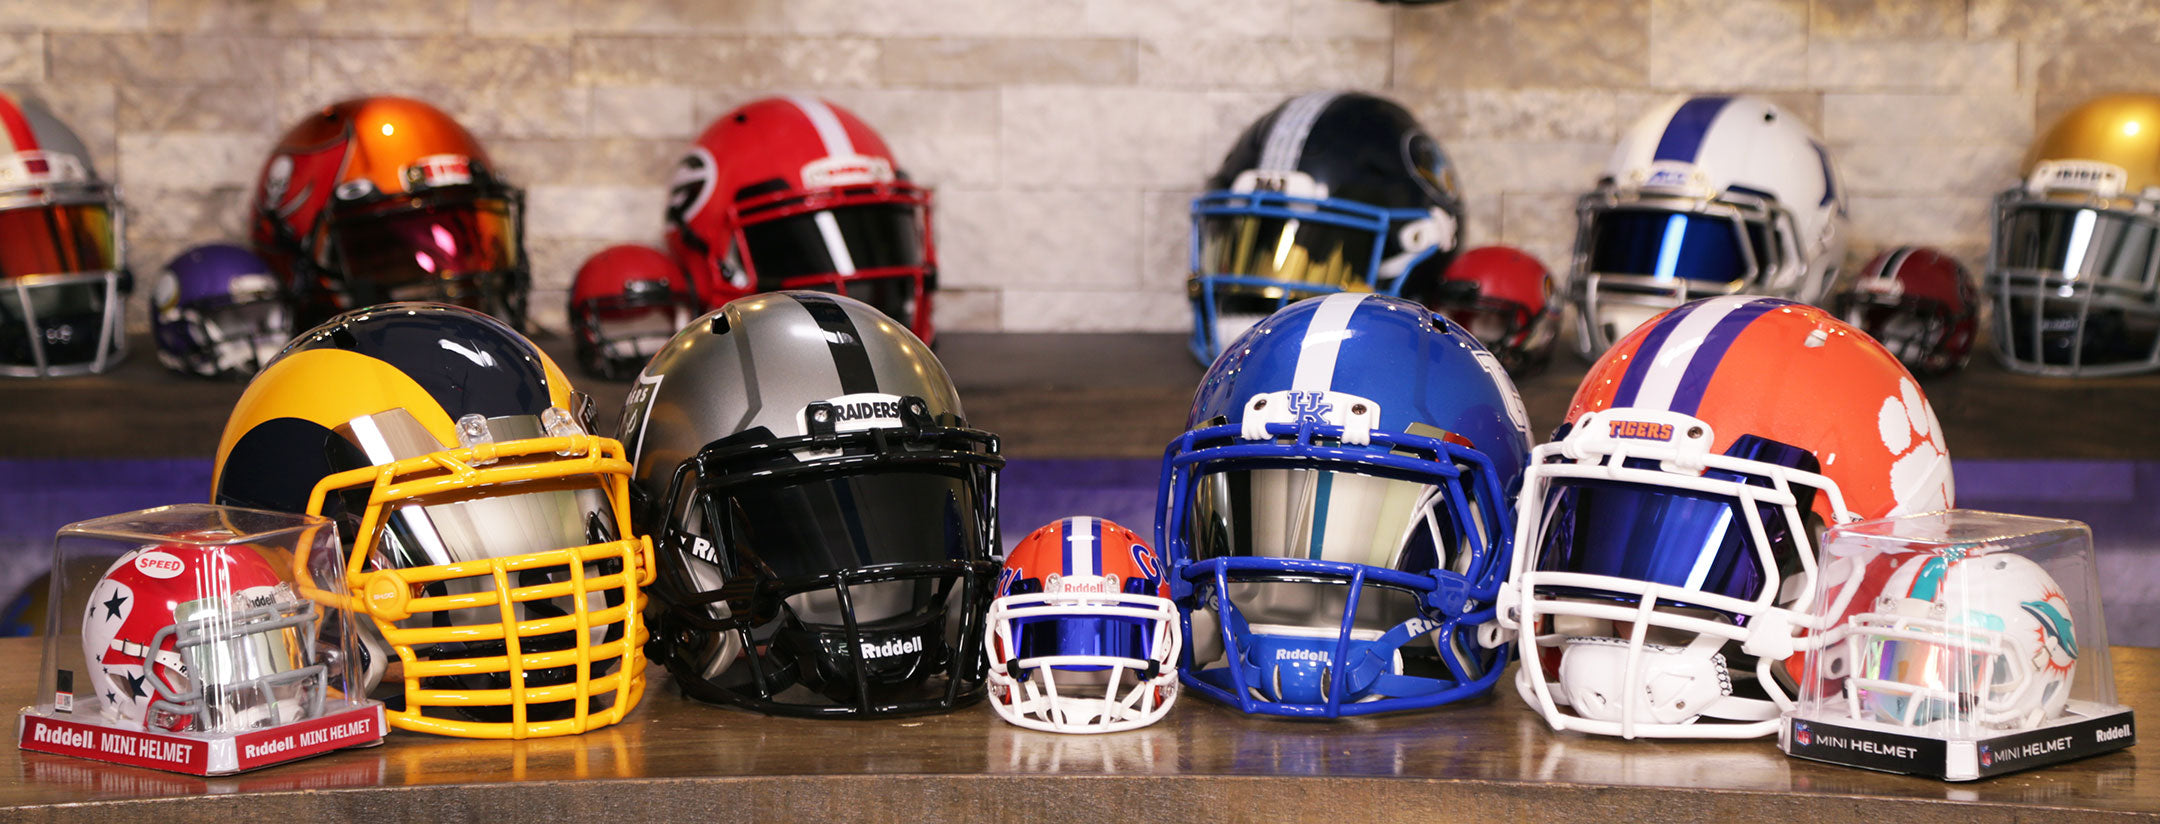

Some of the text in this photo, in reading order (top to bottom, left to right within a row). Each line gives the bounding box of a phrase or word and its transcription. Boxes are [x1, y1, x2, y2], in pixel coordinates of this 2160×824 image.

[834, 402, 900, 421] RAIDERS
[1609, 420, 1674, 442] TIGERS
[140, 558, 181, 571] SPEED
[1064, 583, 1104, 593] Riddell
[861, 636, 922, 659] Riddell
[1276, 648, 1329, 662] Riddell
[34, 723, 192, 764] Riddell MINI HELMET
[245, 719, 370, 759] Riddell MINI HELMET
[2096, 724, 2131, 743] Riddell
[1816, 735, 1918, 759] MINI HELMET
[1994, 747, 2021, 763] MINI
[2022, 737, 2073, 758] HELMET
